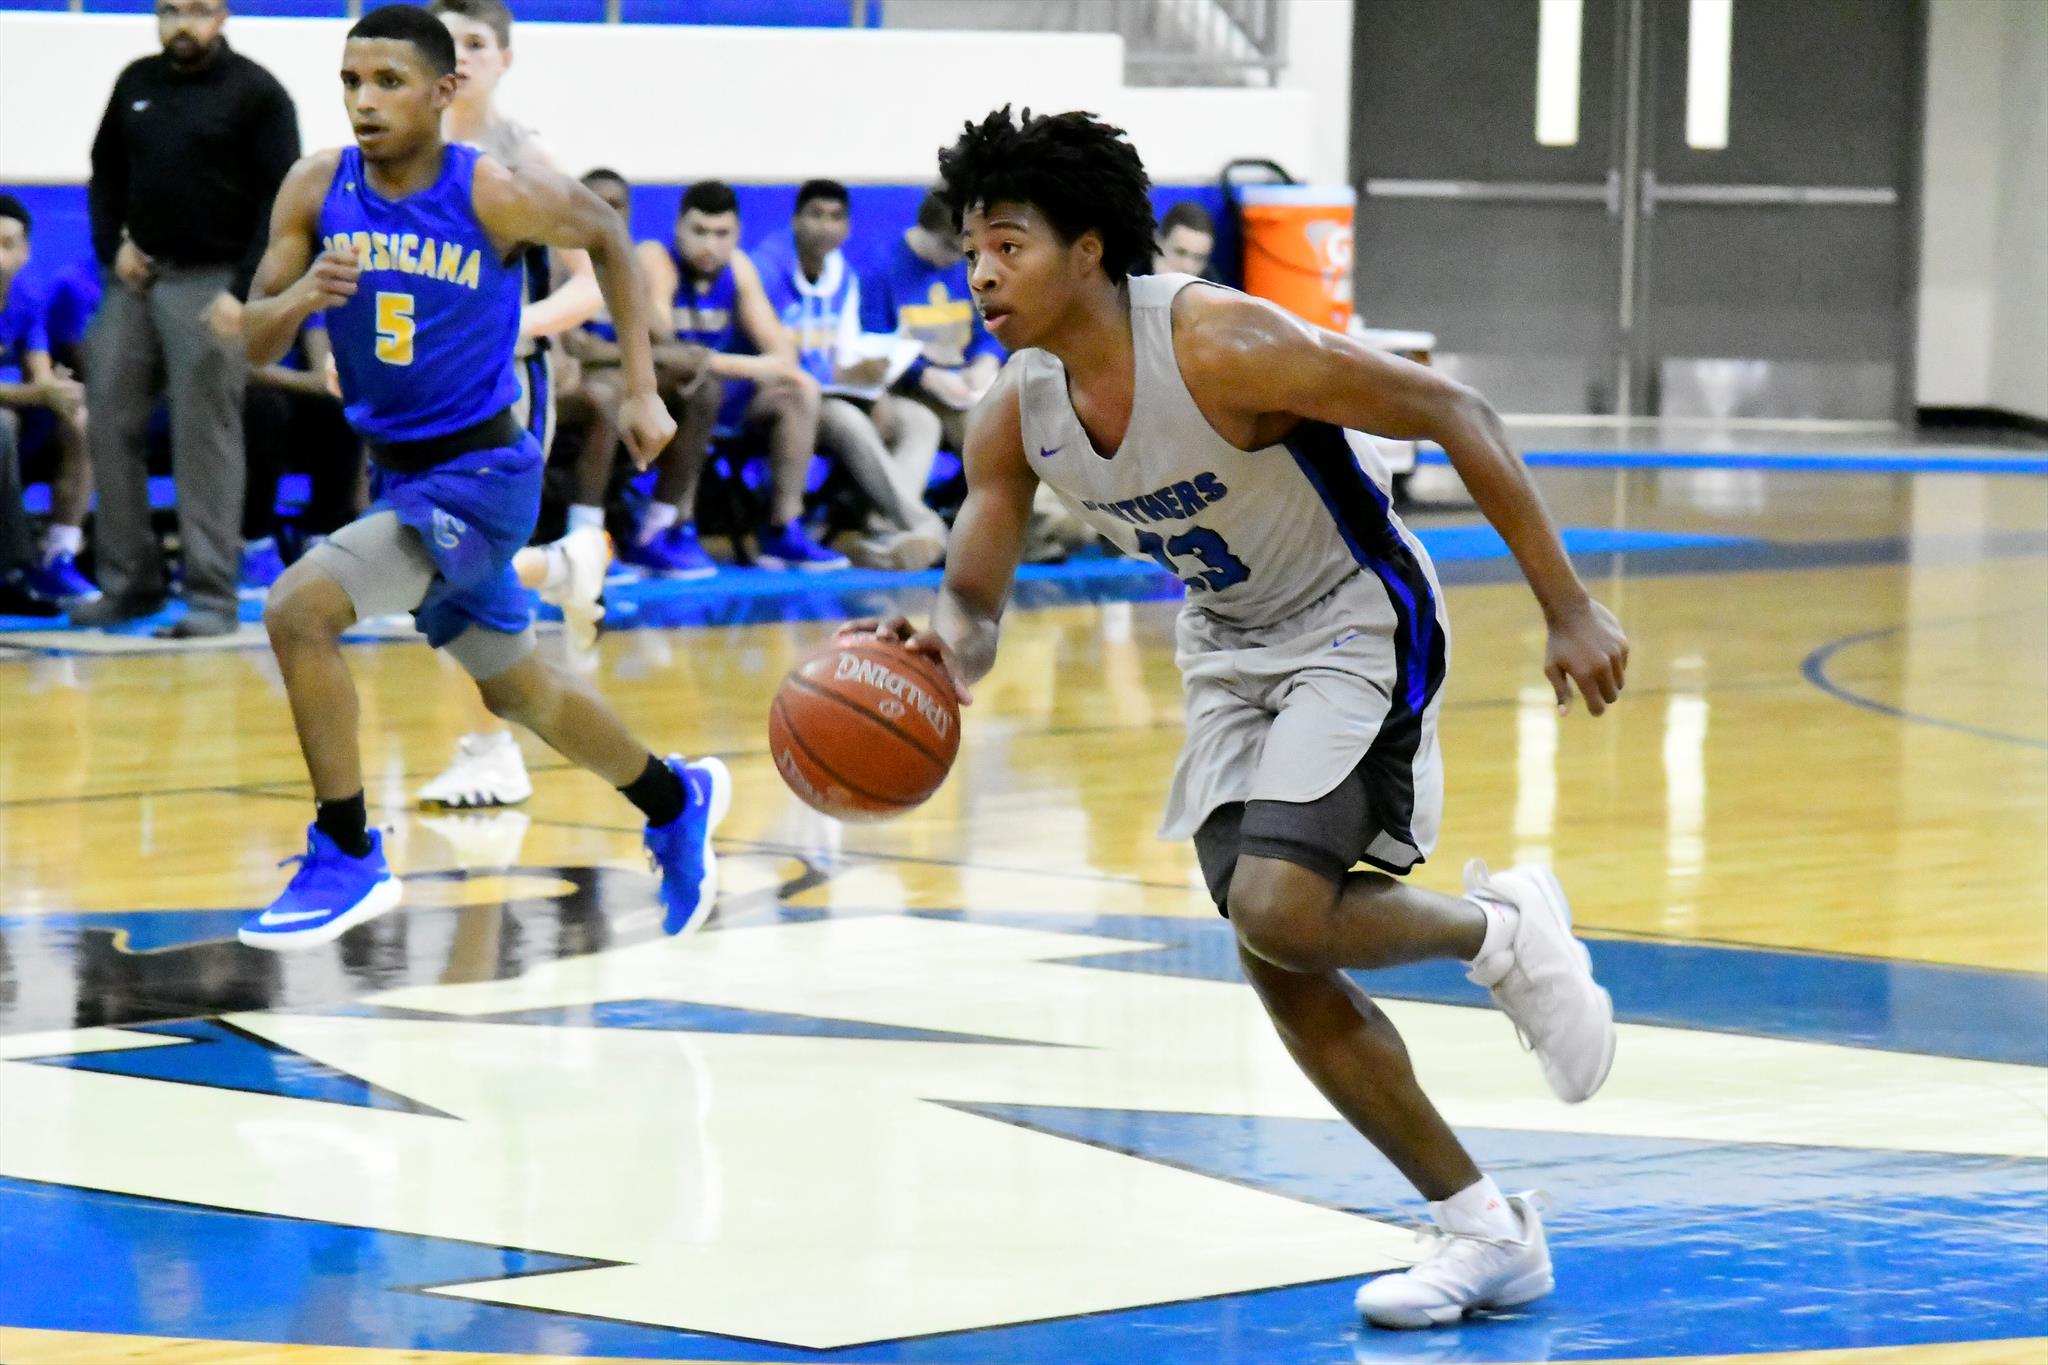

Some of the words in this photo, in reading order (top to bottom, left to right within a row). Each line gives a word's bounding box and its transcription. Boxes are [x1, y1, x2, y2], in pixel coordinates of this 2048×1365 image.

[323, 231, 482, 290] RSICANA
[375, 291, 416, 366] 5
[1080, 472, 1228, 524] NTHERS
